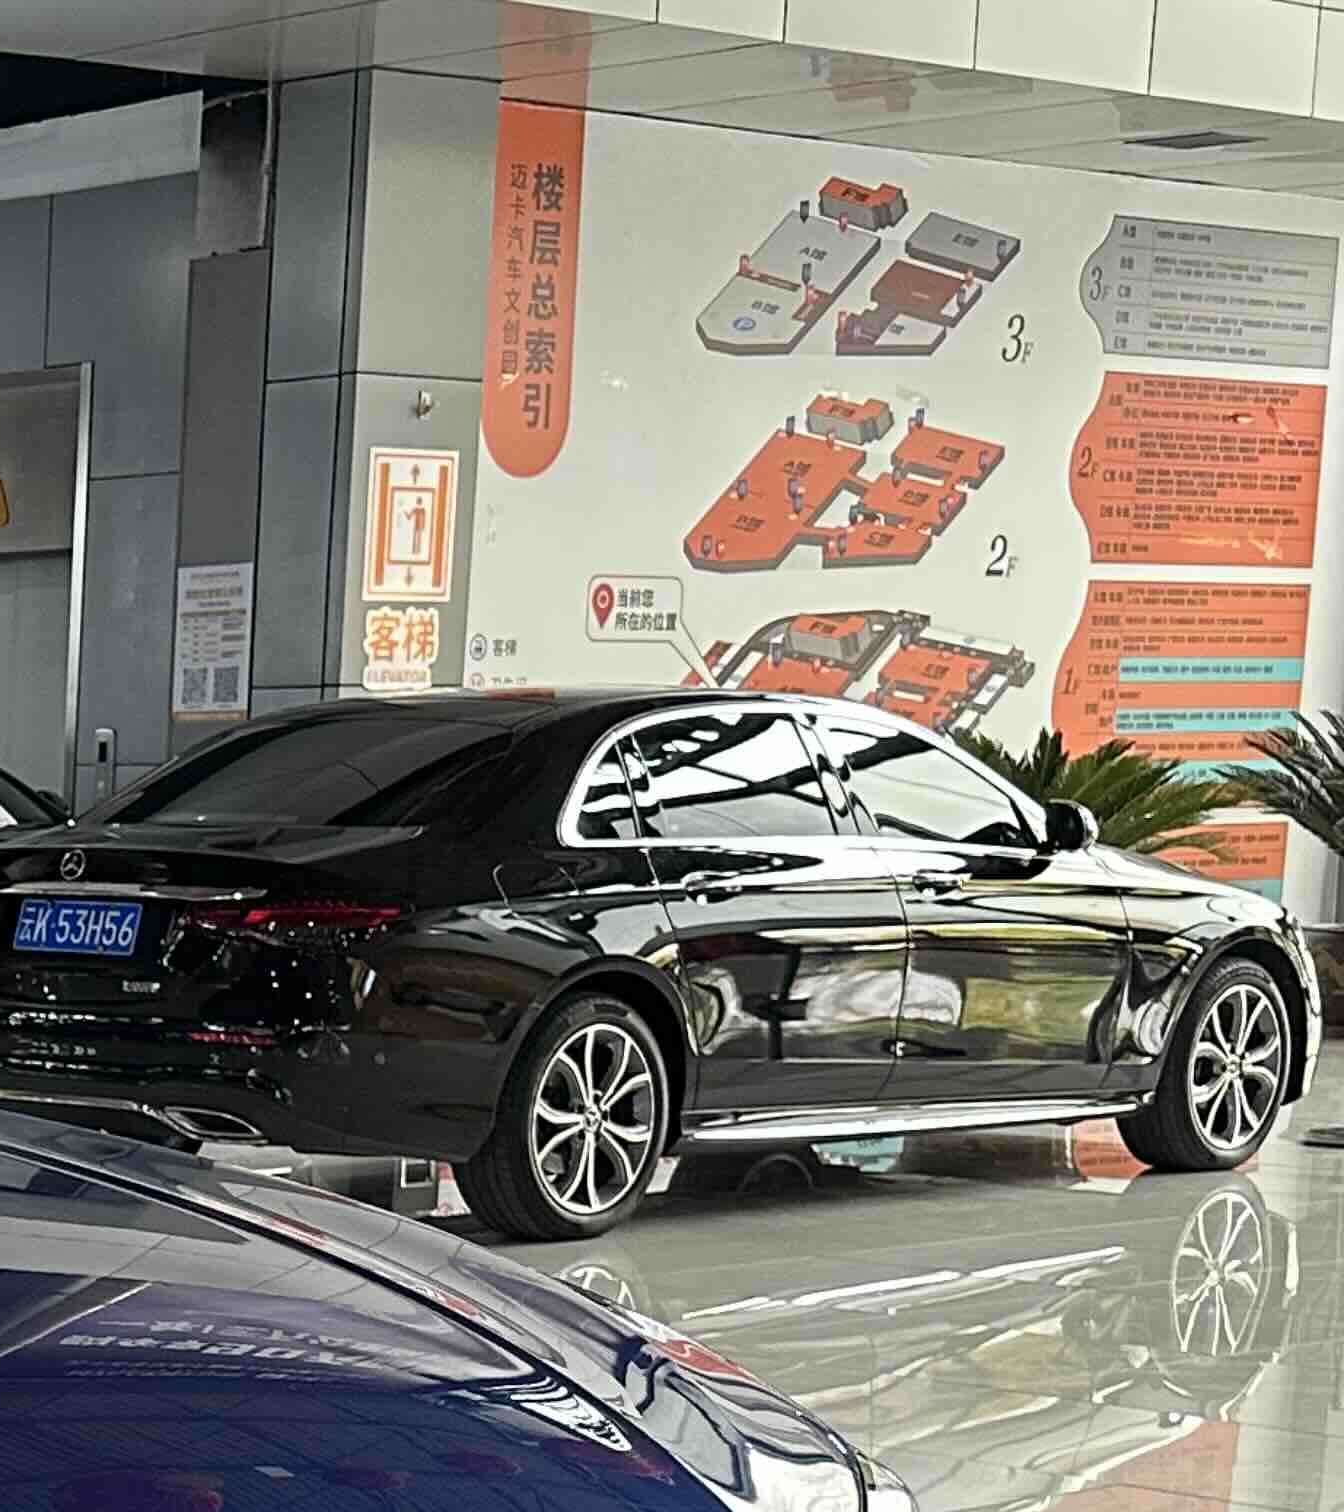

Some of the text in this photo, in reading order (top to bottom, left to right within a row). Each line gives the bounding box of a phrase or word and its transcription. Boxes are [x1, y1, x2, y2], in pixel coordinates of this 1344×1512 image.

[521, 162, 564, 430] 楼层总索引
[1001, 314, 1034, 363] 3F
[986, 534, 1018, 578] 2F
[369, 609, 435, 663] 客梯
[615, 611, 678, 632] 所在的位置
